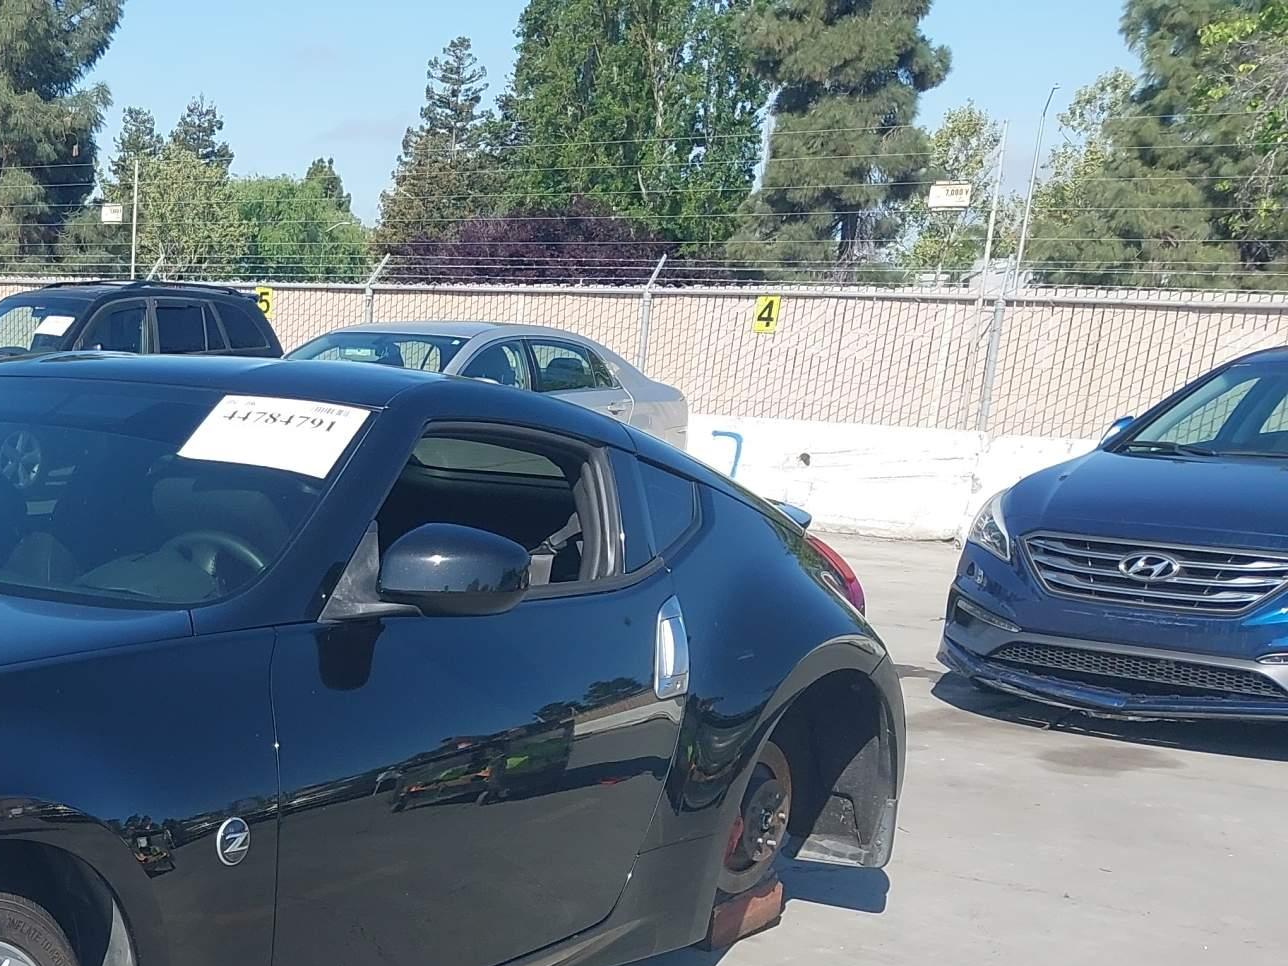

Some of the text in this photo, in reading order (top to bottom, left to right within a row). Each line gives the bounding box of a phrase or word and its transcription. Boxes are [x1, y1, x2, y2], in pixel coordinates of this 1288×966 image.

[259, 291, 270, 313] 5
[757, 299, 774, 327] 4
[223, 410, 337, 432] 44784791
